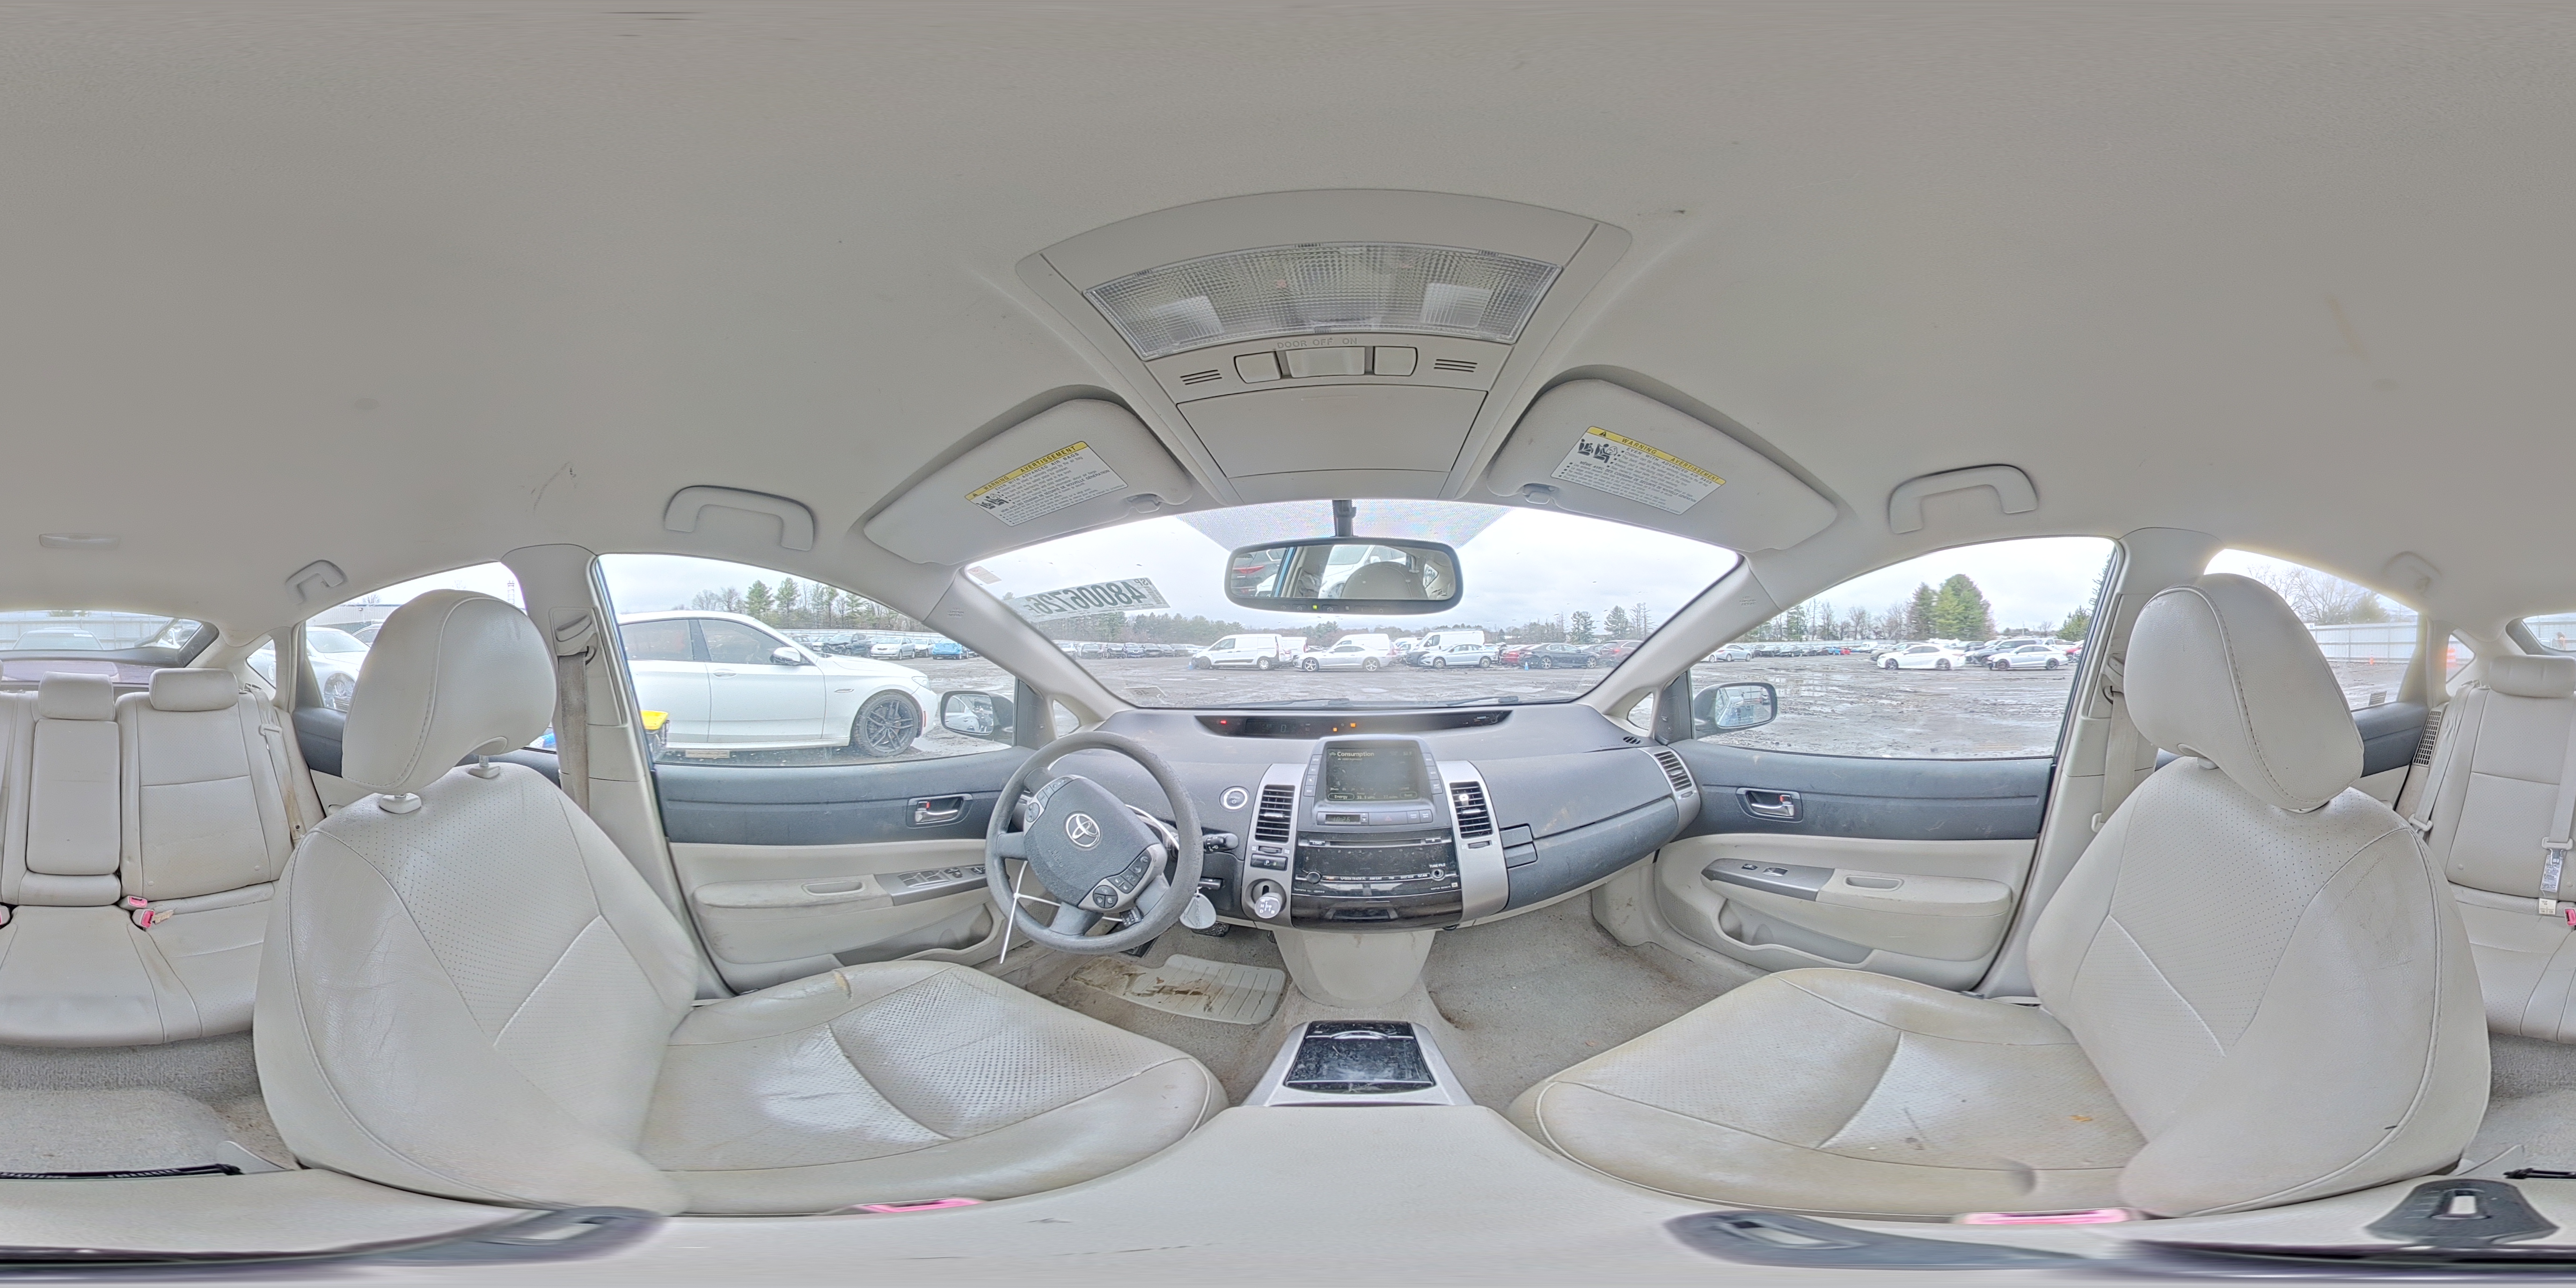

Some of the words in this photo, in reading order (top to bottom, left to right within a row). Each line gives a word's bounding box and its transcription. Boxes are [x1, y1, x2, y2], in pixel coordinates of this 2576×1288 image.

[1277, 340, 1307, 349] DOOR
[983, 476, 1010, 490] WARNING
[1020, 446, 1076, 473] AVERTISSEMENT
[1022, 465, 1048, 478] ADVANCED
[1063, 452, 1079, 461] BAGS
[1622, 438, 1657, 454] WARNING
[1670, 458, 1720, 481] AVERTISSEMENT
[1661, 461, 1689, 474] ADVANCED
